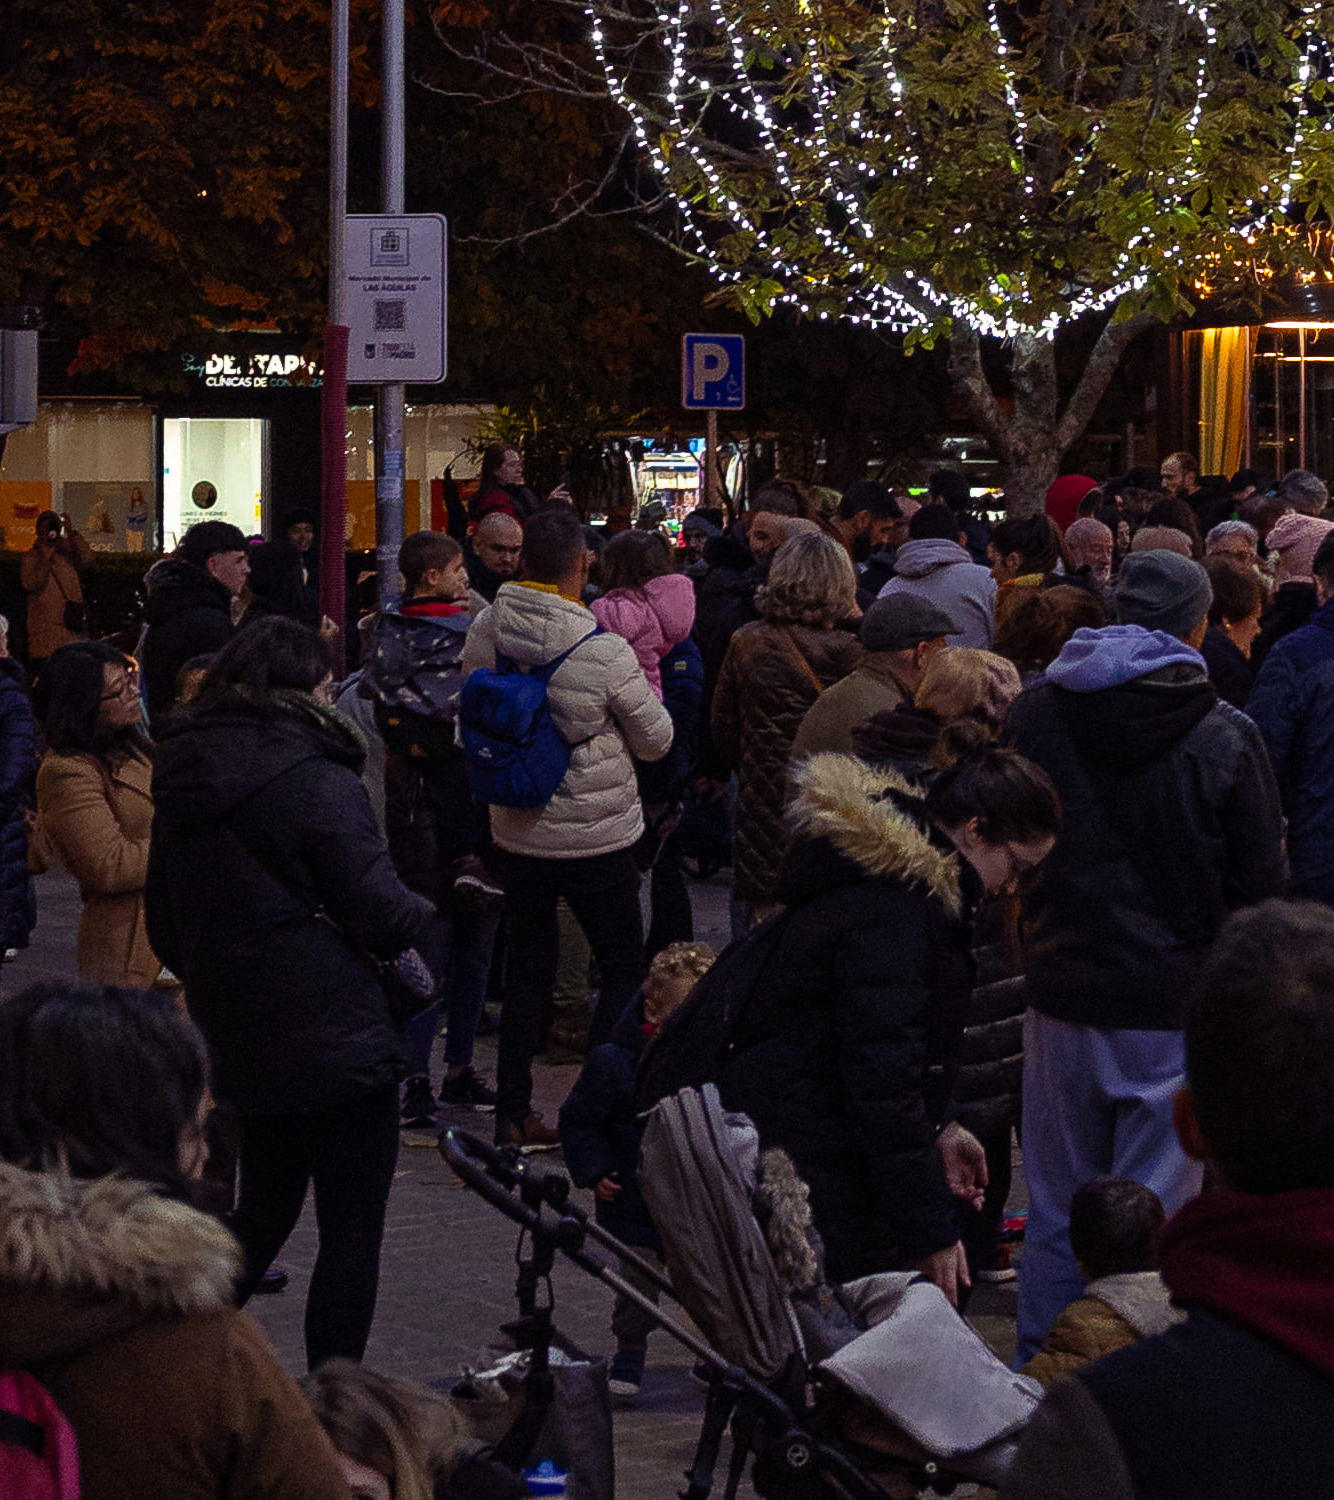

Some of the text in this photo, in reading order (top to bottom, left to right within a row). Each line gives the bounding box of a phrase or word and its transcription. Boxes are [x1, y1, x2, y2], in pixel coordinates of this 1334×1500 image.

[363, 284, 379, 292] LAS
[693, 342, 730, 400] P
[253, 377, 267, 388] DE
